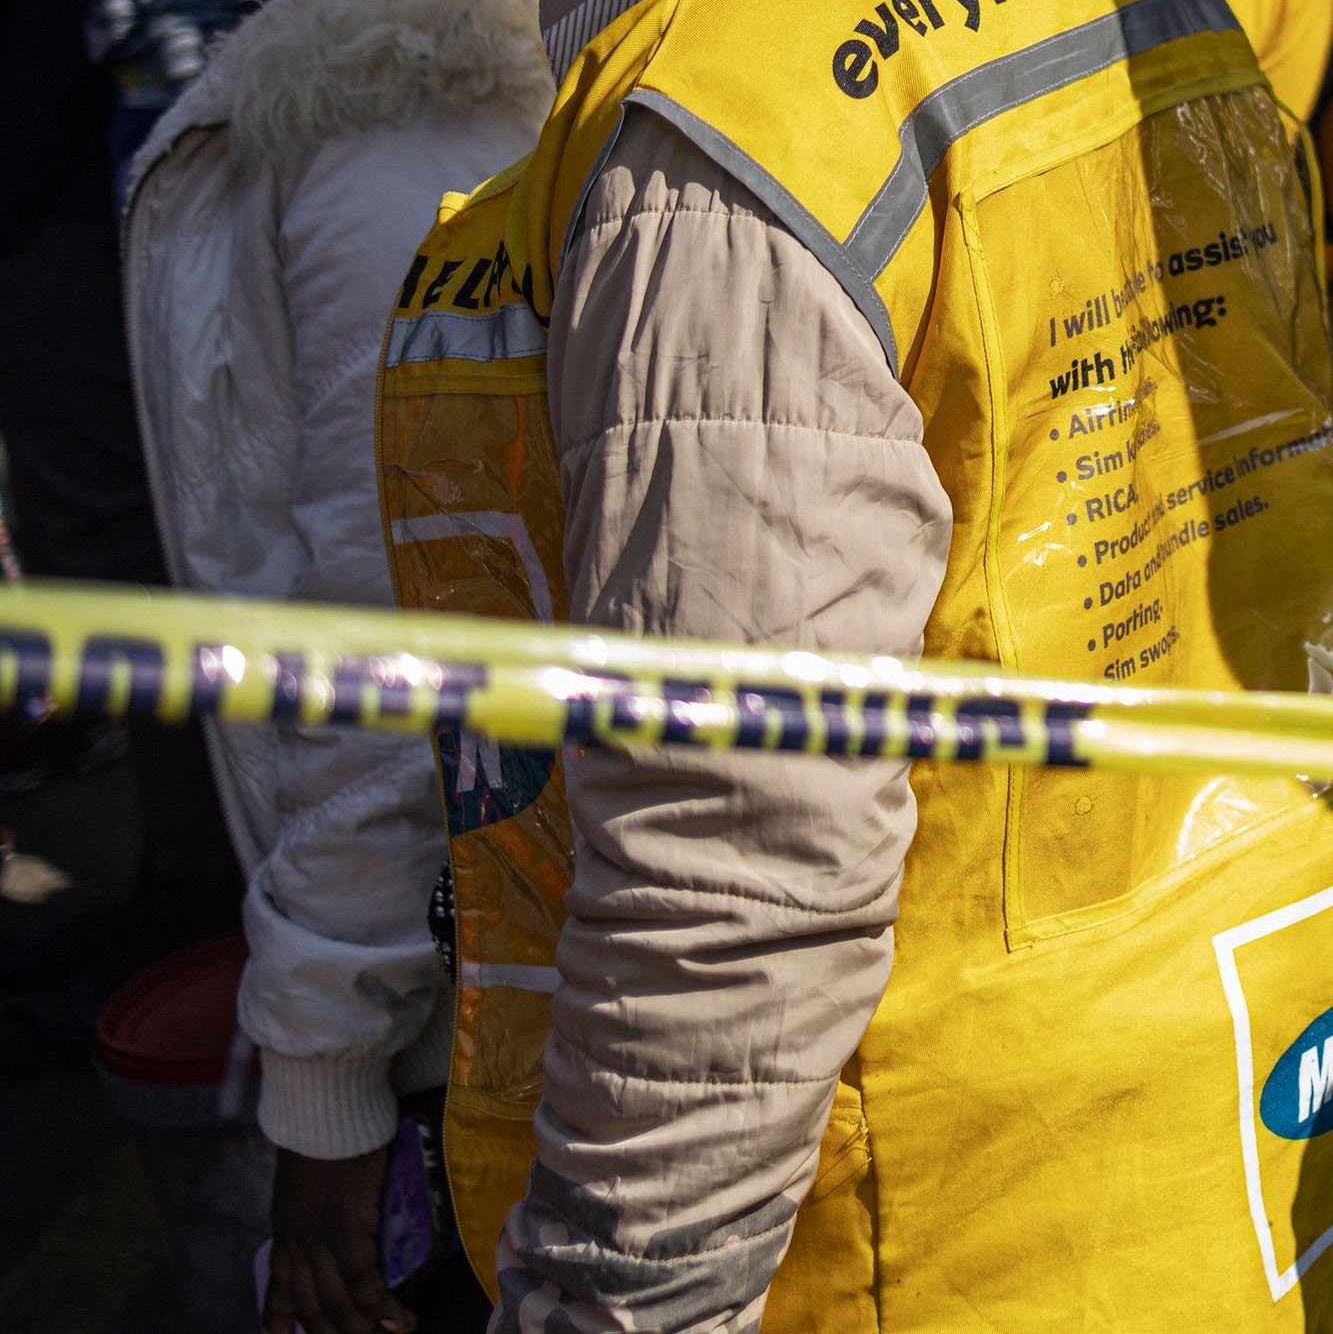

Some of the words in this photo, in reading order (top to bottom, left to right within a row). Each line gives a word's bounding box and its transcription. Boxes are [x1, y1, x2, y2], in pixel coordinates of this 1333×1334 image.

[1049, 317, 1056, 348] I
[1063, 293, 1111, 339] will
[1168, 227, 1248, 277] assist
[1248, 222, 1279, 259] you
[1049, 351, 1116, 400] with
[1075, 450, 1124, 481] Sim
[1094, 511, 1150, 565] Product
[1166, 468, 1236, 510] service
[1099, 568, 1141, 607] Data
[1214, 494, 1270, 532] sales.
[1102, 597, 1164, 649] Porting.
[1103, 656, 1136, 683] Sim
